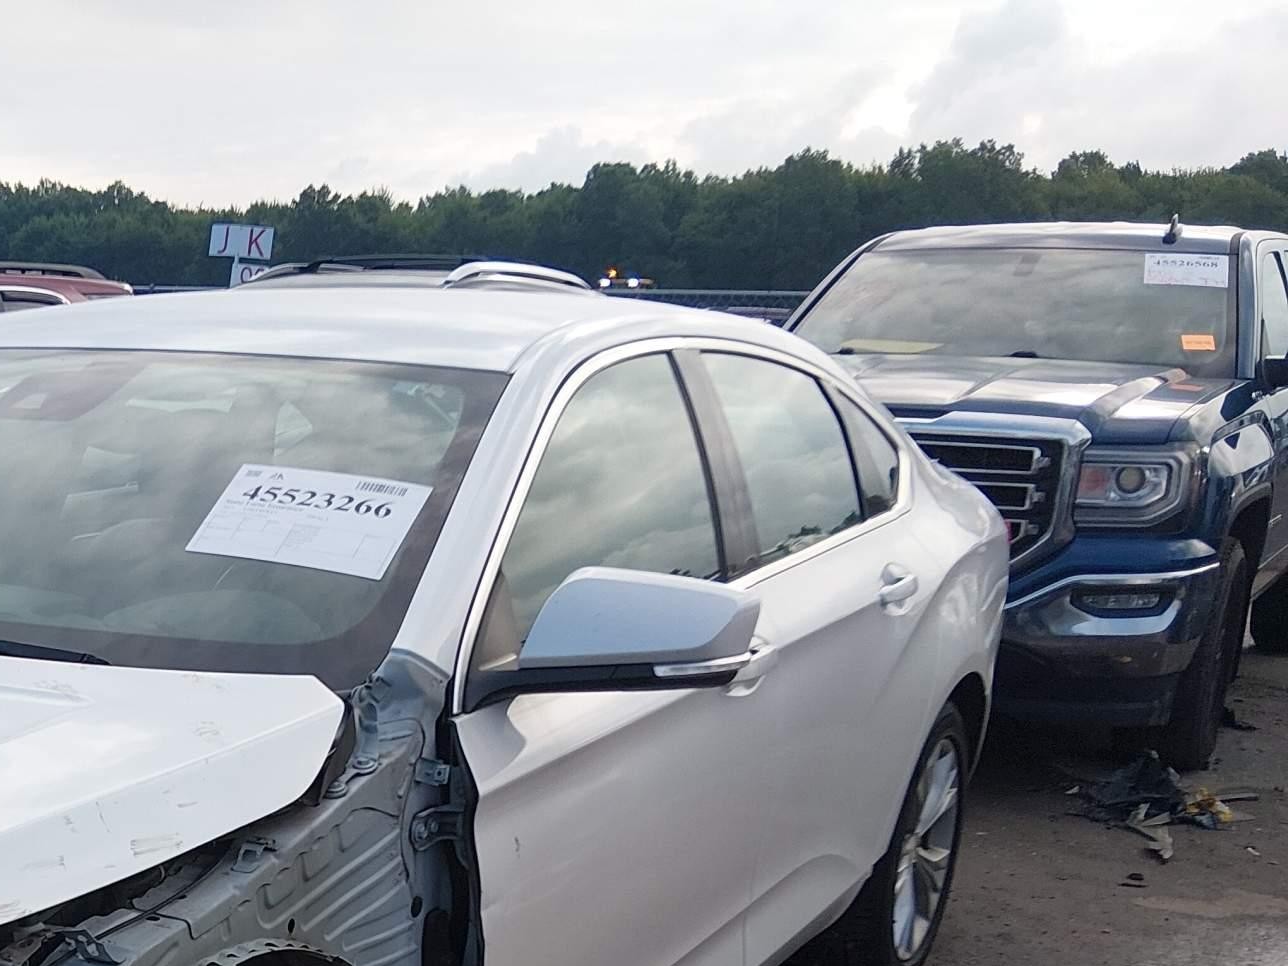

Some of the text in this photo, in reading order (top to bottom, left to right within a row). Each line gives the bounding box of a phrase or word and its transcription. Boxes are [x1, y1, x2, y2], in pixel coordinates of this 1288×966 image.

[217, 225, 267, 258] J K
[242, 484, 393, 519] 45523266
